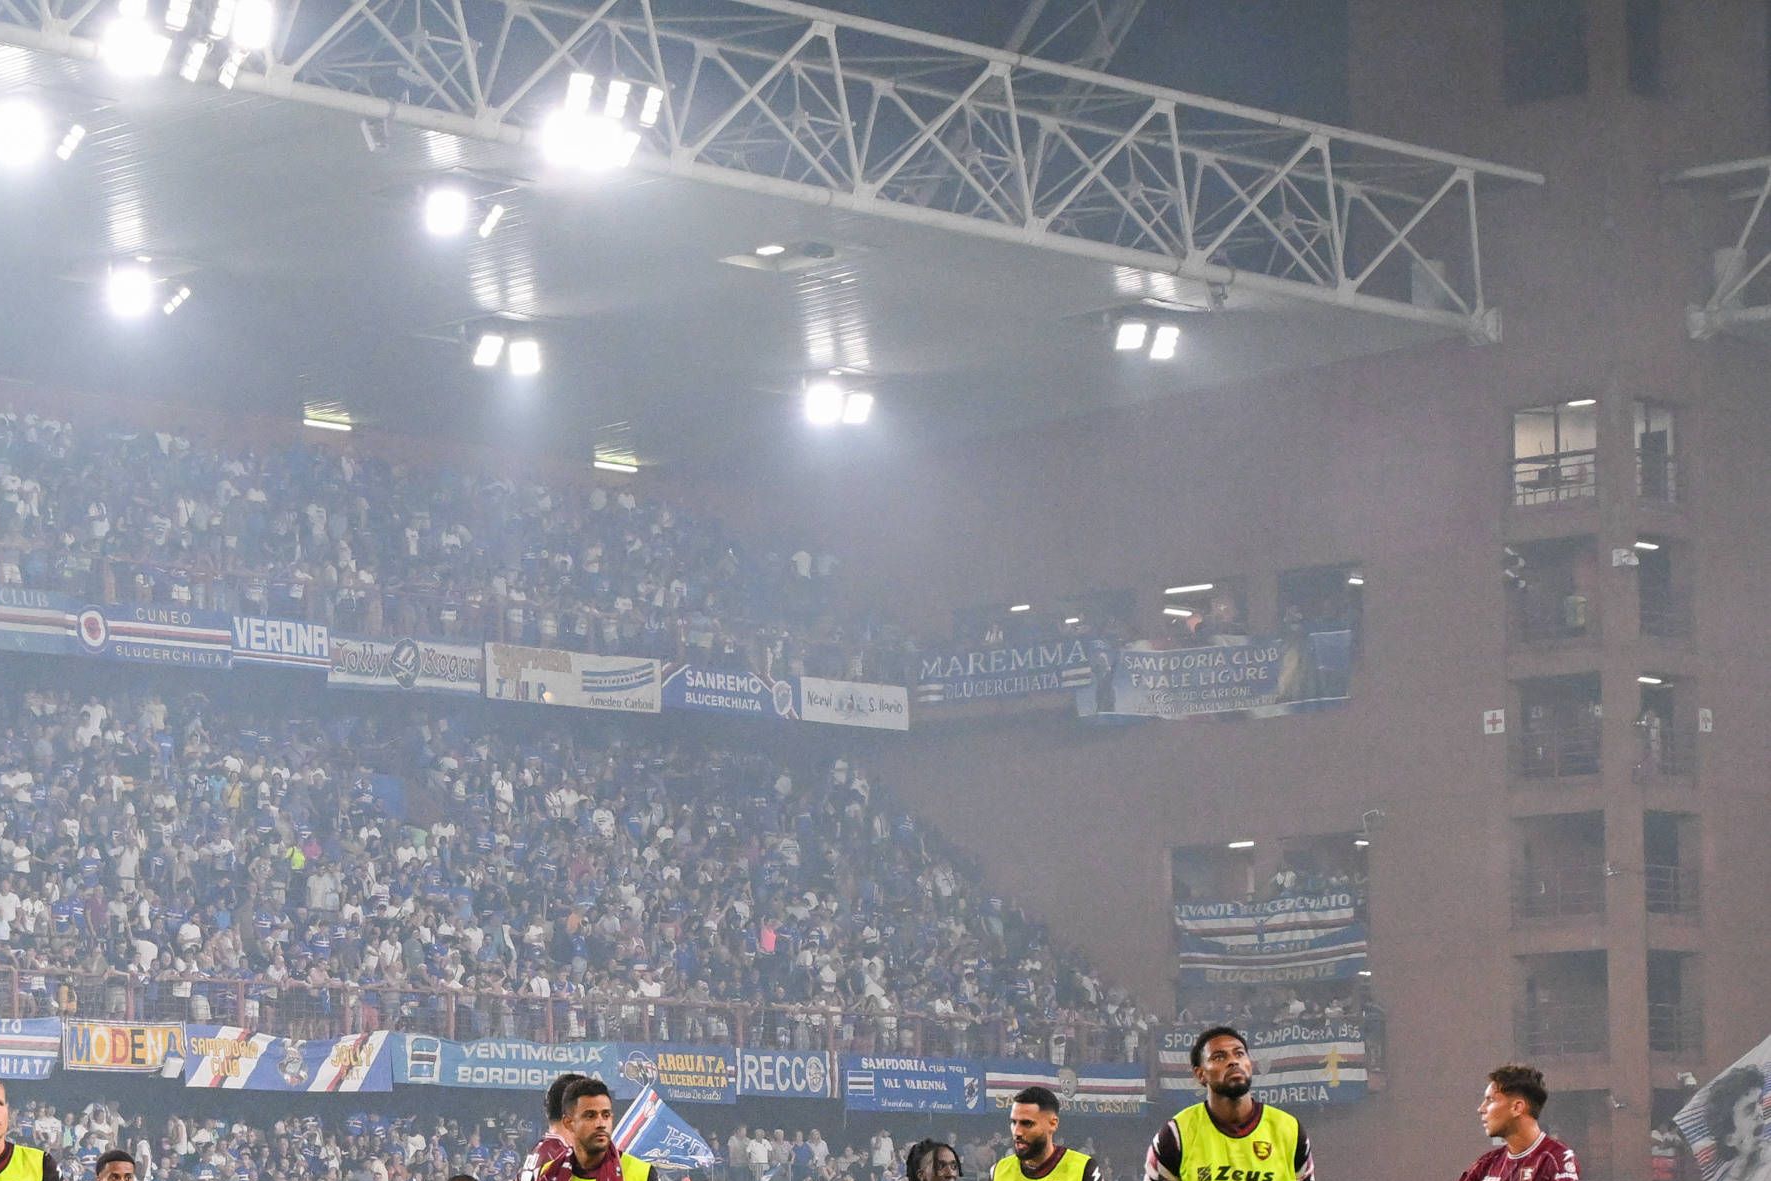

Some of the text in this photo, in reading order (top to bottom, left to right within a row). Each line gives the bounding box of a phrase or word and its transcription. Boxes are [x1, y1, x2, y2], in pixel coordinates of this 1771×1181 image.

[0, 585, 48, 608] CLUB
[136, 608, 191, 624] CUNEO
[232, 617, 328, 656] VERONA
[116, 646, 220, 664] BLUCERCHIATA
[334, 642, 387, 679] Jolly
[422, 648, 475, 682] Roger
[920, 640, 1088, 680] MAREMMA
[1232, 647, 1278, 665] CLUB
[685, 670, 762, 695] SANREMO
[1199, 666, 1268, 686] LIGURE
[685, 692, 762, 711] BLUCERCHIATA
[70, 1025, 186, 1065] MODENA
[462, 1042, 604, 1064] VENTIMIGLIA
[211, 1057, 240, 1077] CLUB
[658, 1054, 725, 1073] ARQUATA
[744, 1055, 827, 1092] RECCO
[861, 1057, 928, 1073] SAMPDORIA
[883, 1078, 948, 1091] VAL VARENNA
